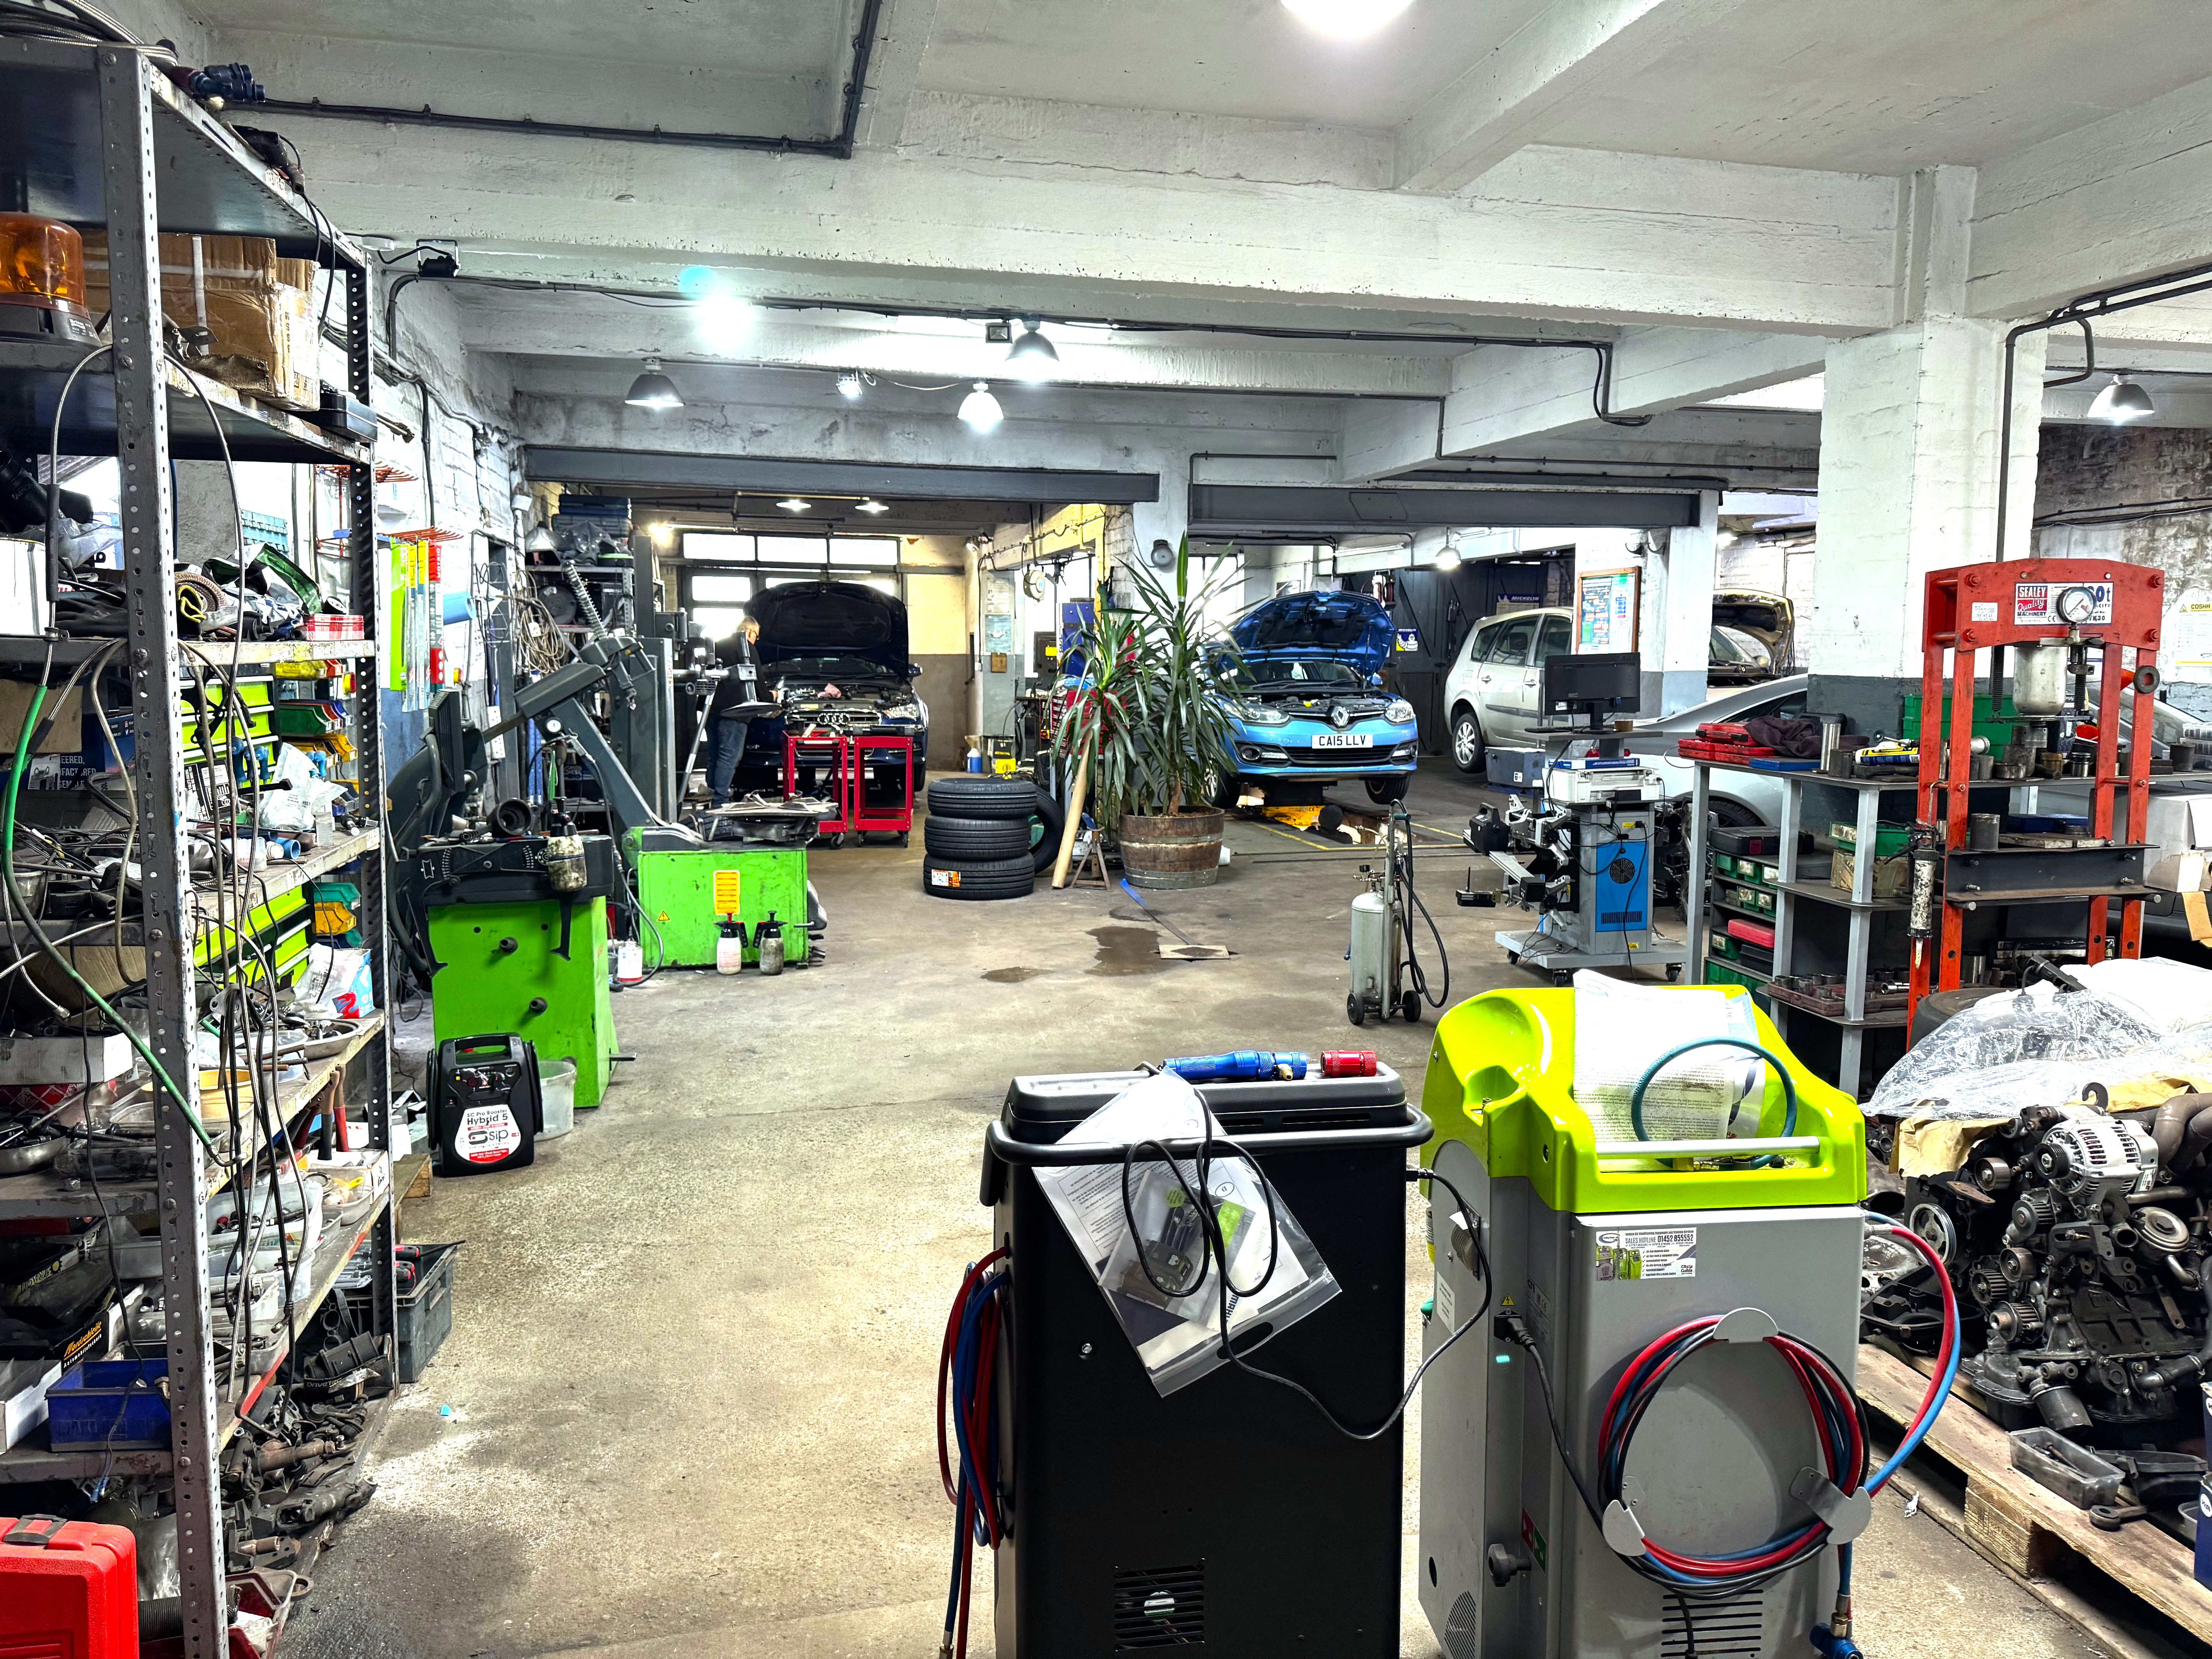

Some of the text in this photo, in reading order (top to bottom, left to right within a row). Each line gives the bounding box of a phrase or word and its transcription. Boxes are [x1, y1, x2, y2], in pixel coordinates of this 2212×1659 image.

[2019, 586, 2046, 598] SEALEY
[2017, 599, 2045, 611] Quality
[1319, 735, 1366, 746] CA15 LLV
[61, 756, 85, 764] EERED,
[467, 1114, 498, 1126] Hybrid
[489, 1130, 508, 1142] sip
